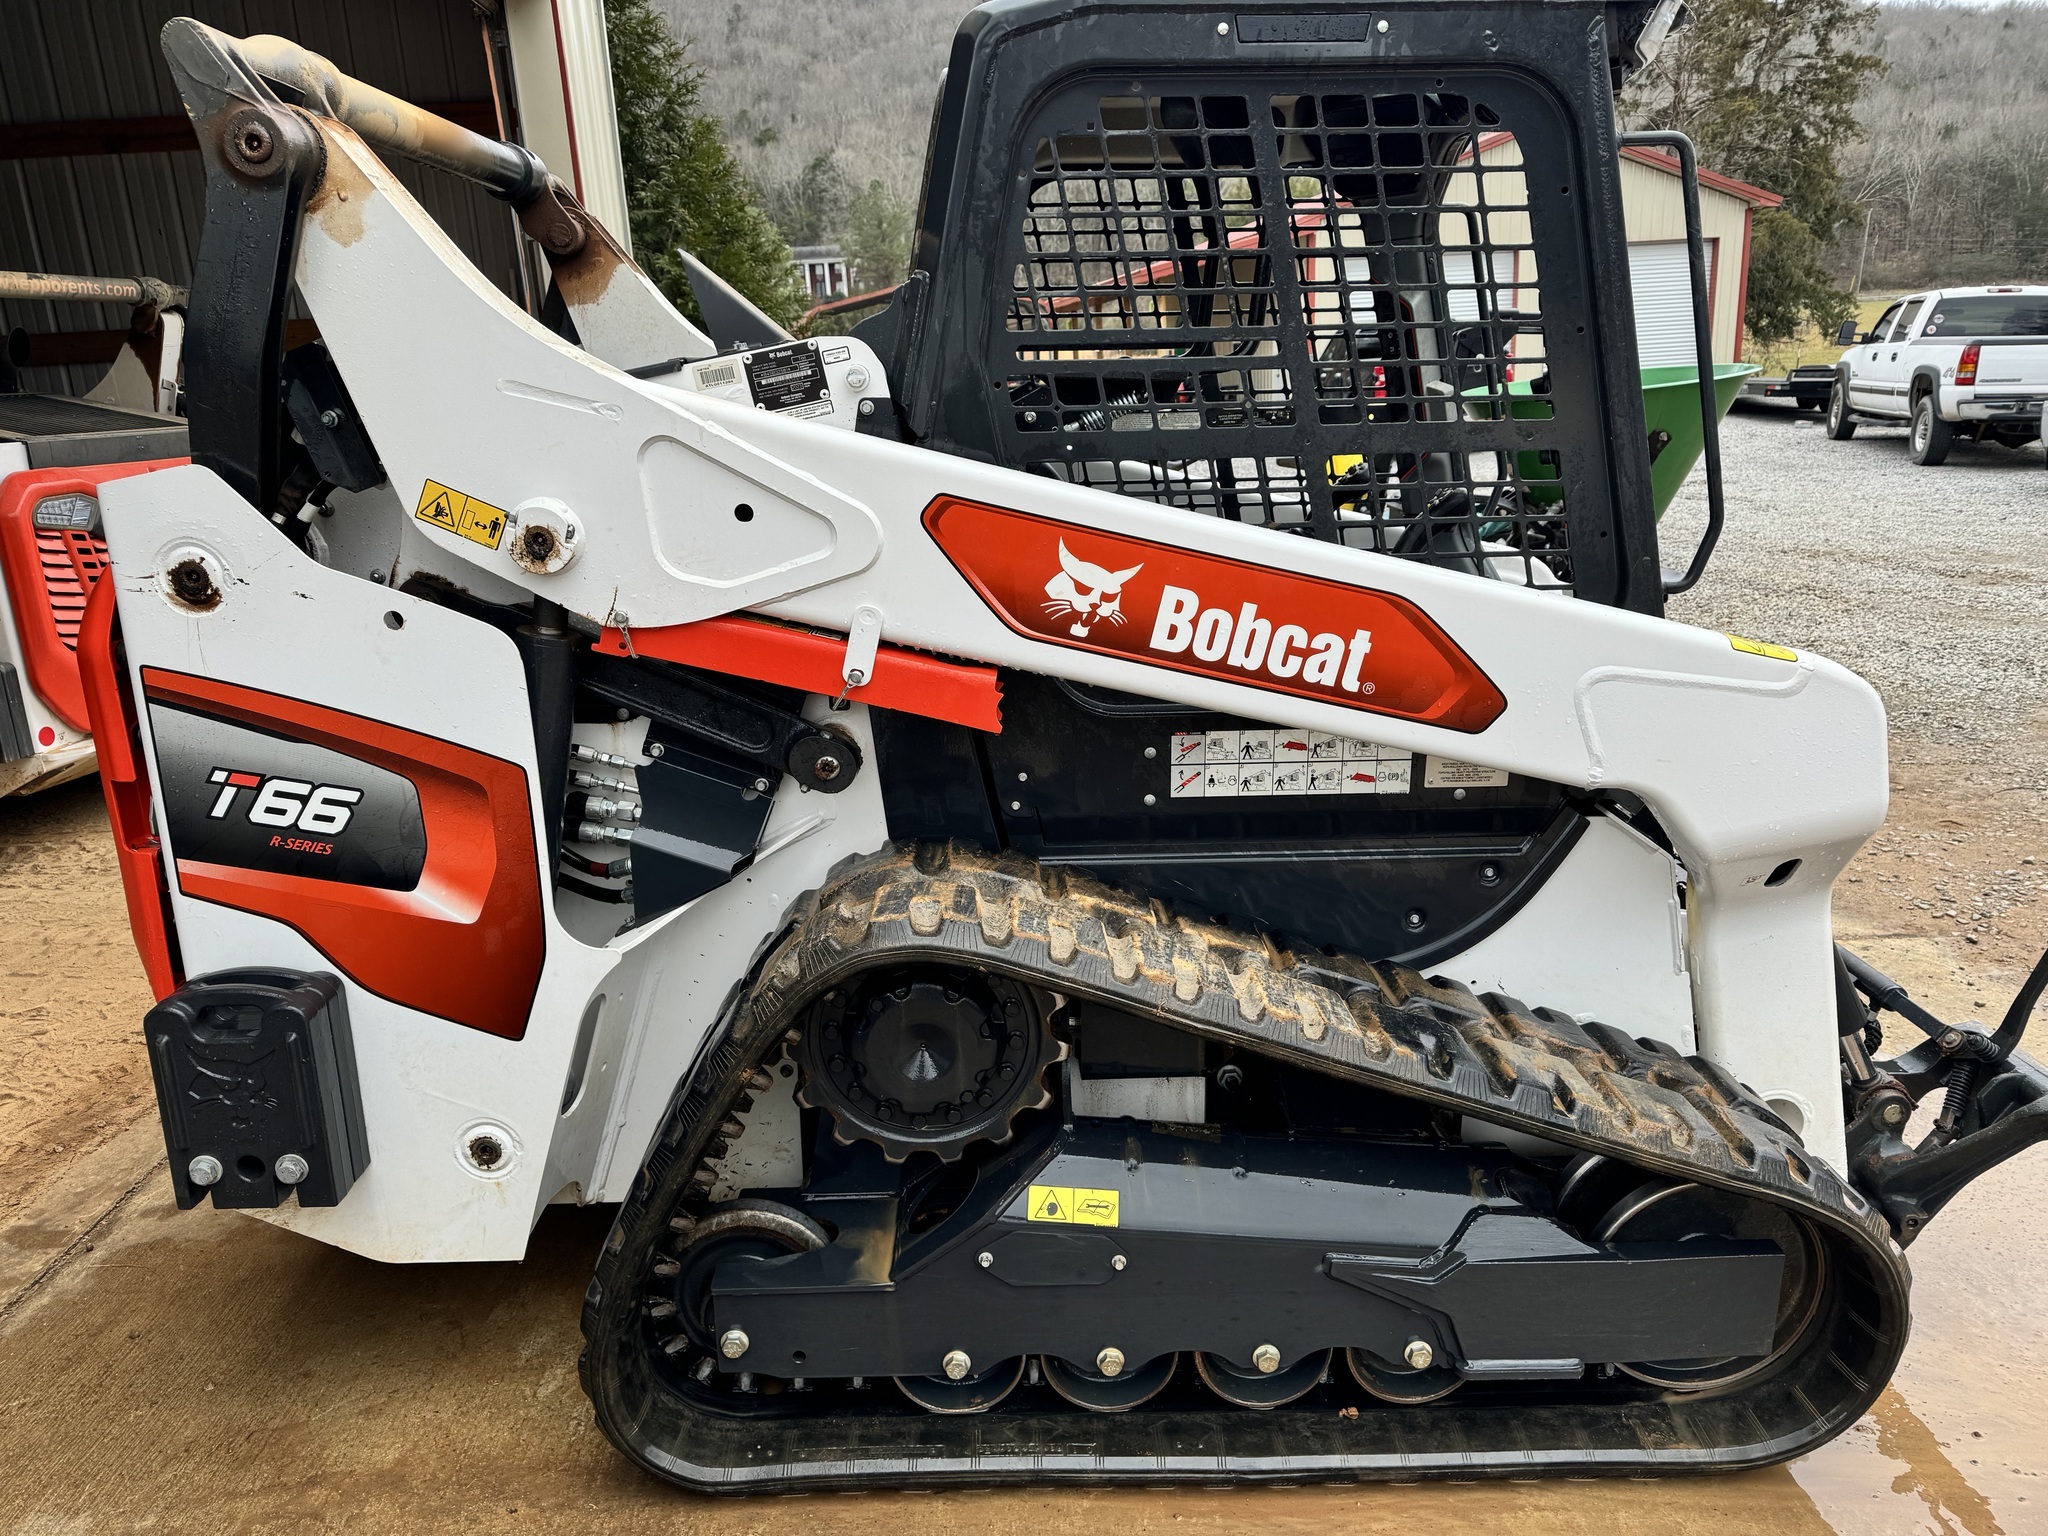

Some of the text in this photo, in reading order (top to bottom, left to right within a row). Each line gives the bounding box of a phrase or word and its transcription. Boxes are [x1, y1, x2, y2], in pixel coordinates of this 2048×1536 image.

[776, 349, 793, 358] Bobcat
[1149, 584, 1373, 694] Bobcat
[208, 768, 363, 835] T66
[269, 835, 334, 855] R-SERIES
